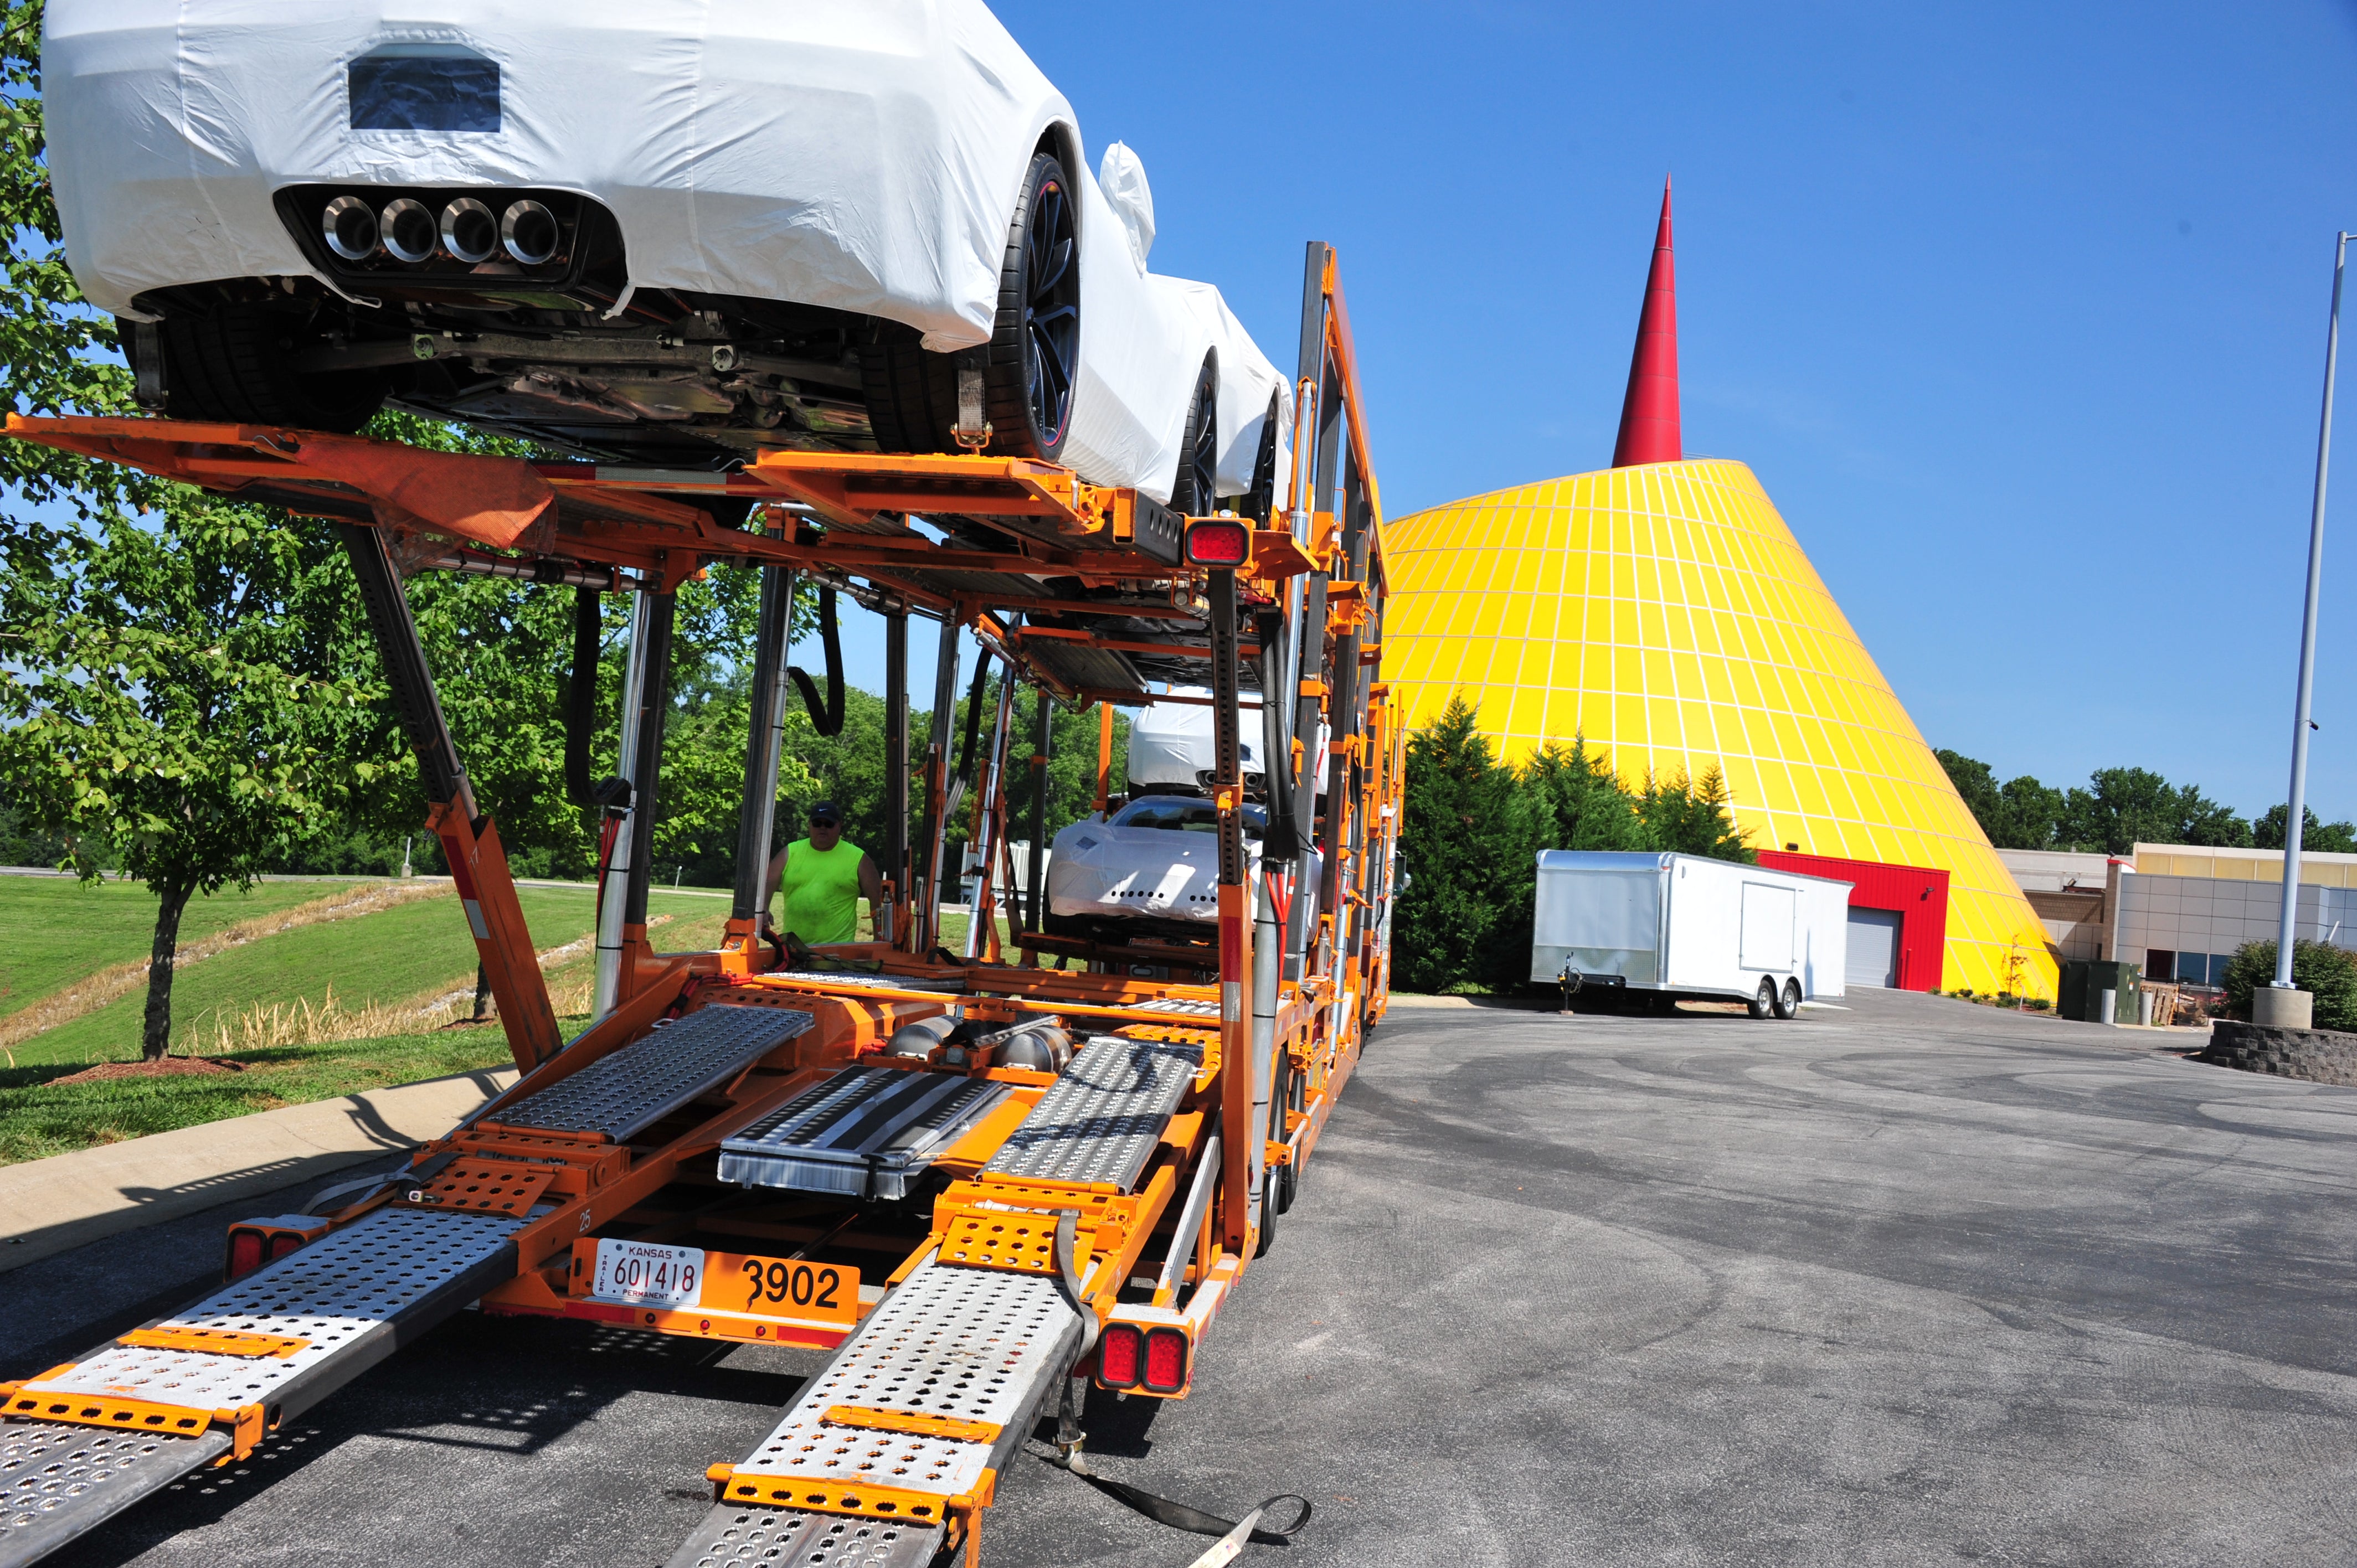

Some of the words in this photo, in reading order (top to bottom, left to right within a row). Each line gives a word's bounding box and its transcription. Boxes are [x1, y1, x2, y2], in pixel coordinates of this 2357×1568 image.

[579, 1208, 591, 1233] 25
[629, 1247, 672, 1260] KANSAS
[599, 1255, 608, 1292] TRAILER
[615, 1257, 695, 1292] 601418
[742, 1259, 840, 1309] 3902
[622, 1289, 669, 1301] PERMANENT
